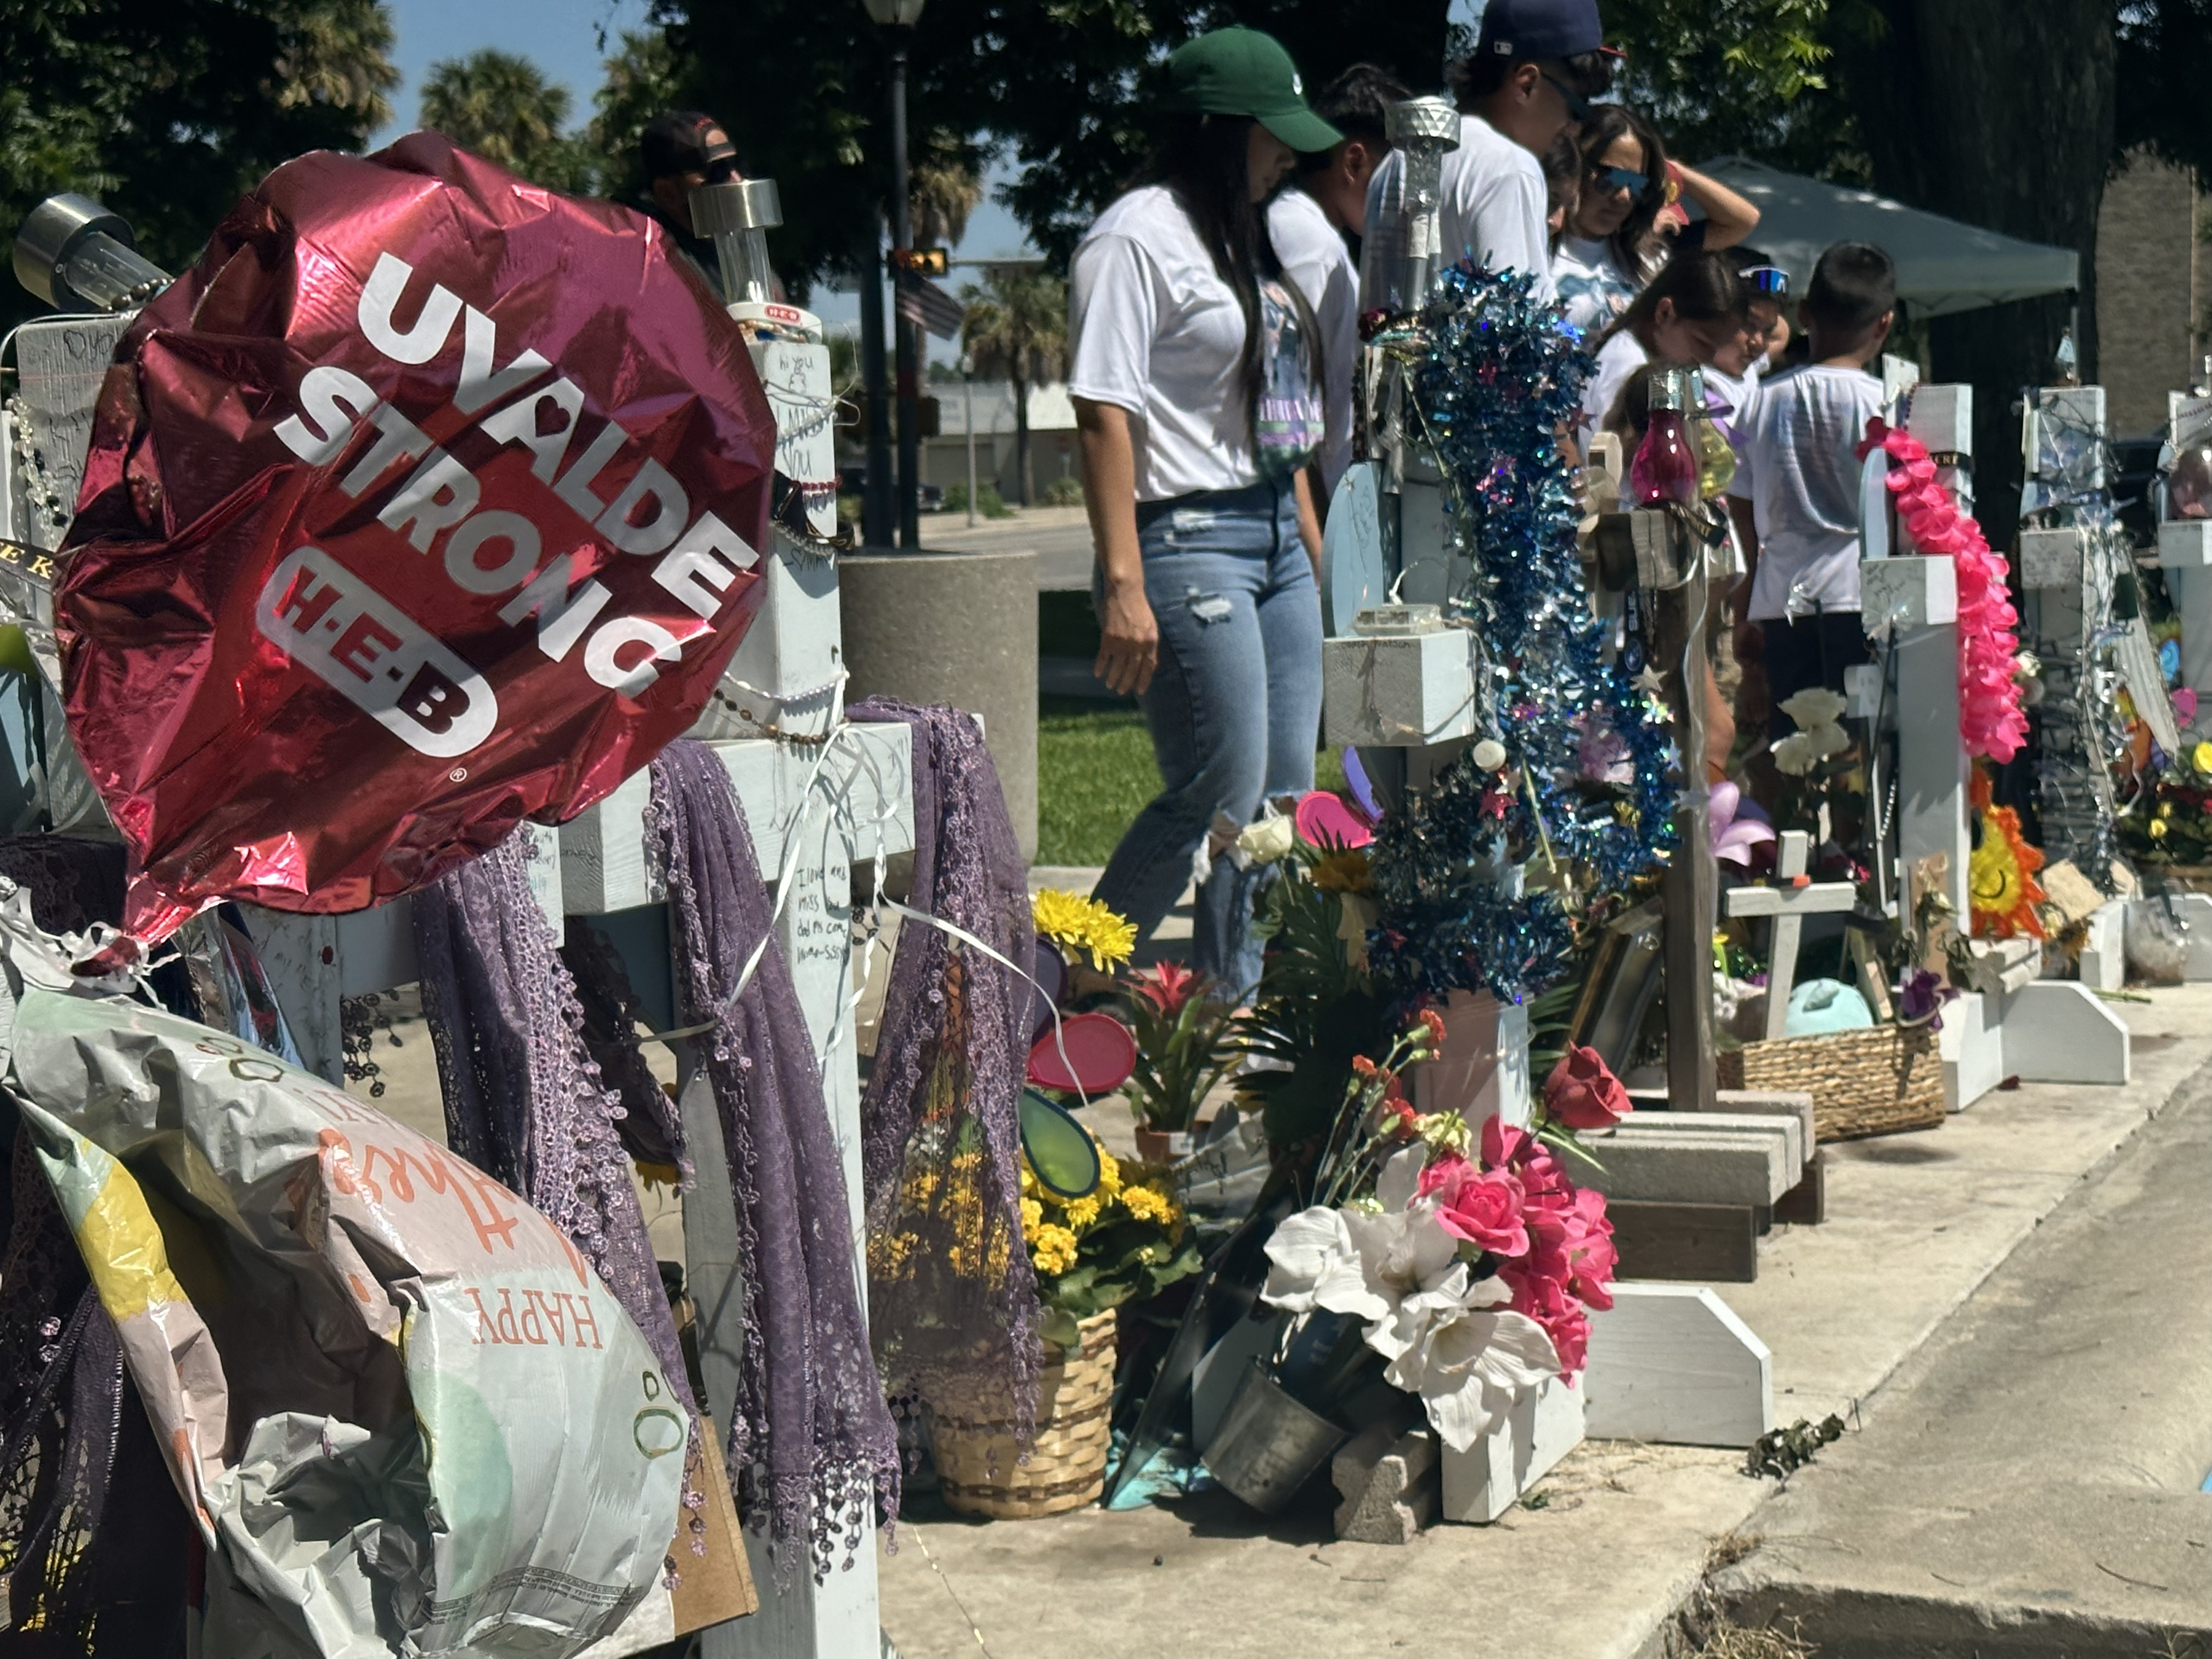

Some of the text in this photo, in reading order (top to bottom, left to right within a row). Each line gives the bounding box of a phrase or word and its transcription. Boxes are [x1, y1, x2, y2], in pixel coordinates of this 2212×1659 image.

[273, 366, 682, 700] STRONG
[358, 251, 759, 620] UVALDE
[464, 1286, 603, 1350] HAPPY
